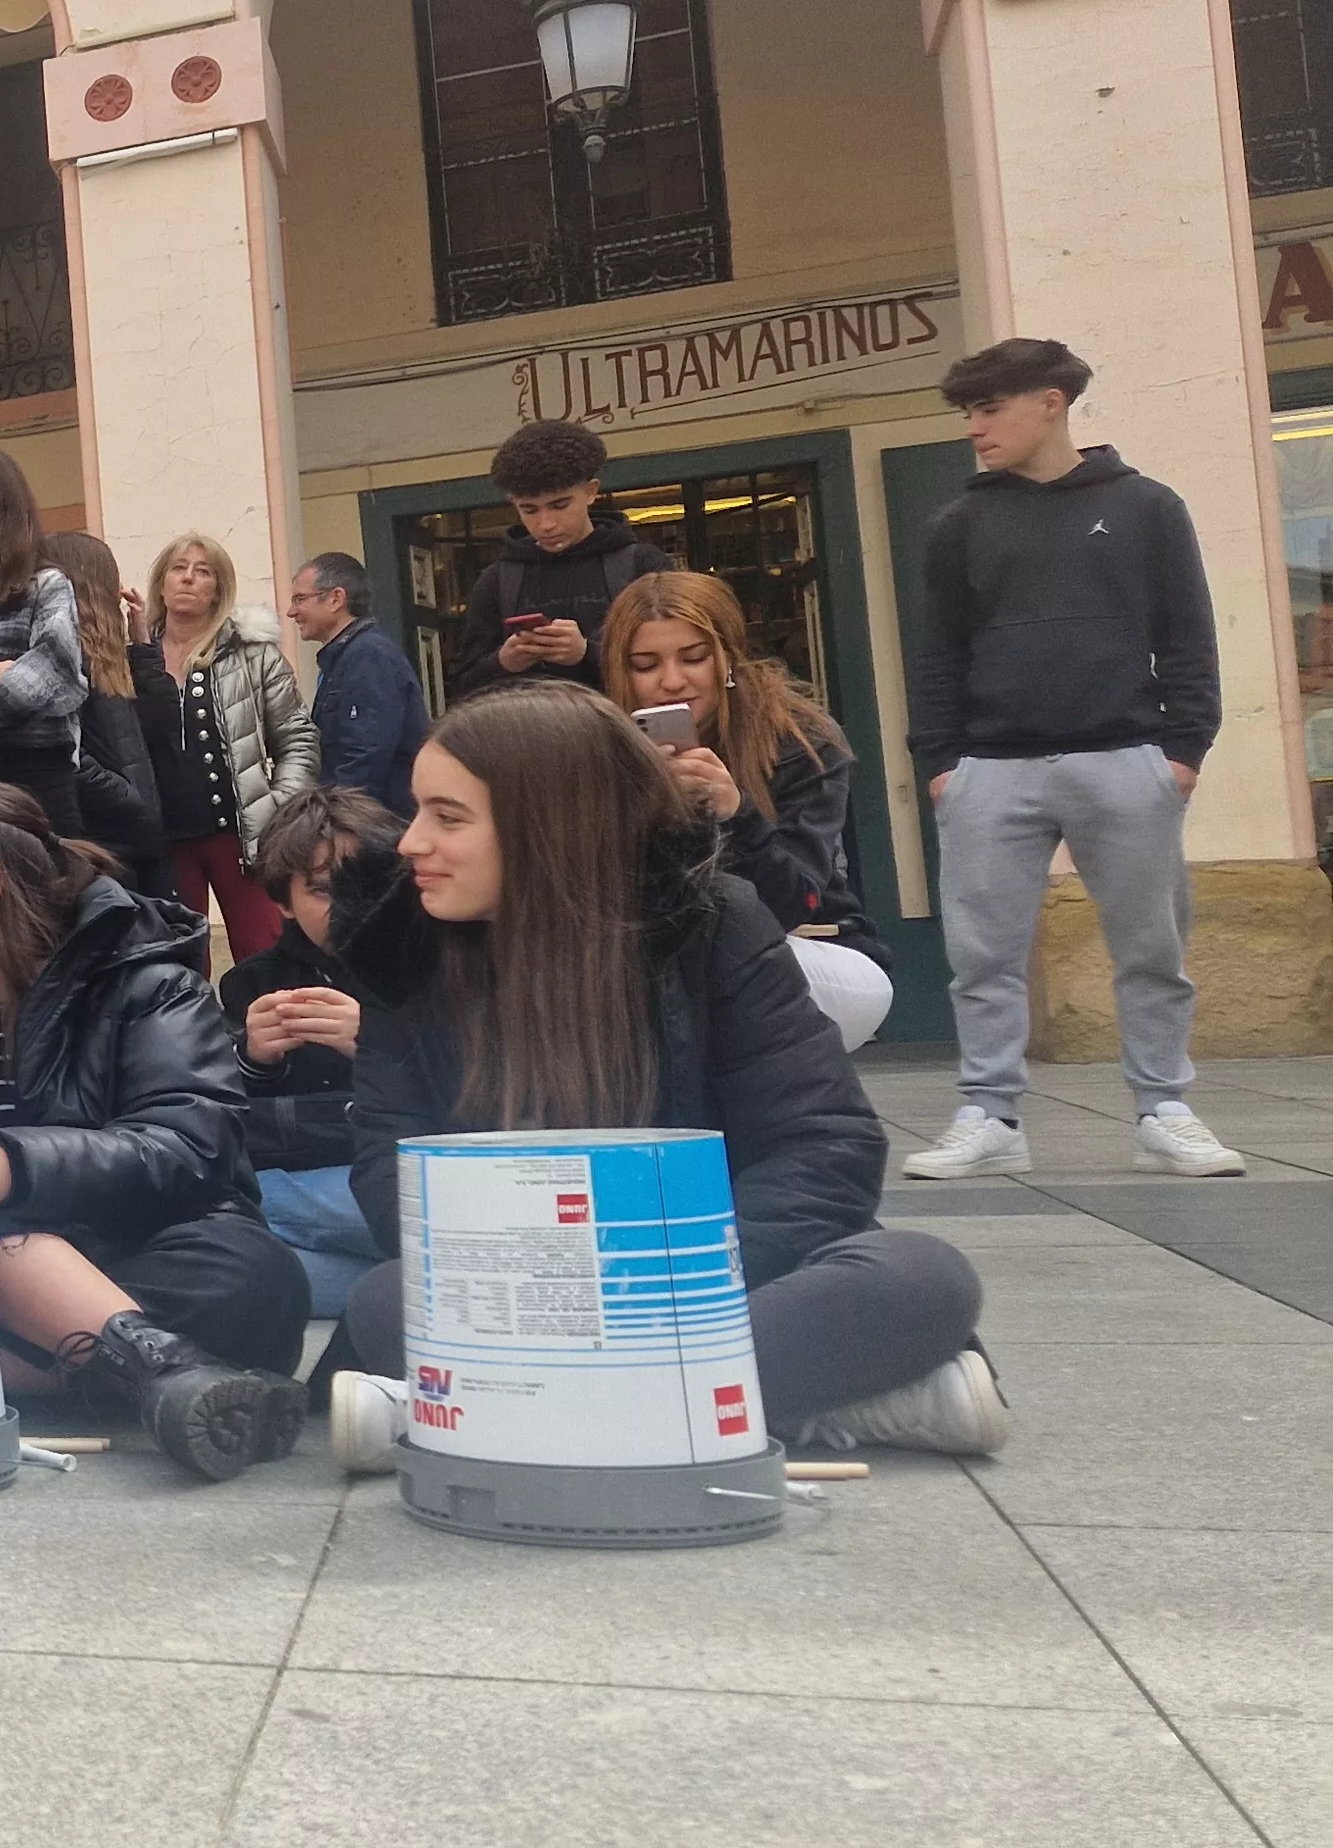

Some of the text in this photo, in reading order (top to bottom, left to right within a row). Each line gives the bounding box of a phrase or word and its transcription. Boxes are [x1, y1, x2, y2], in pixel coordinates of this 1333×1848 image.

[528, 292, 939, 423] ULTRAMARINOS
[558, 1204, 587, 1213] JUNO
[413, 1399, 464, 1430] JUNO
[717, 1402, 746, 1420] JUNO
